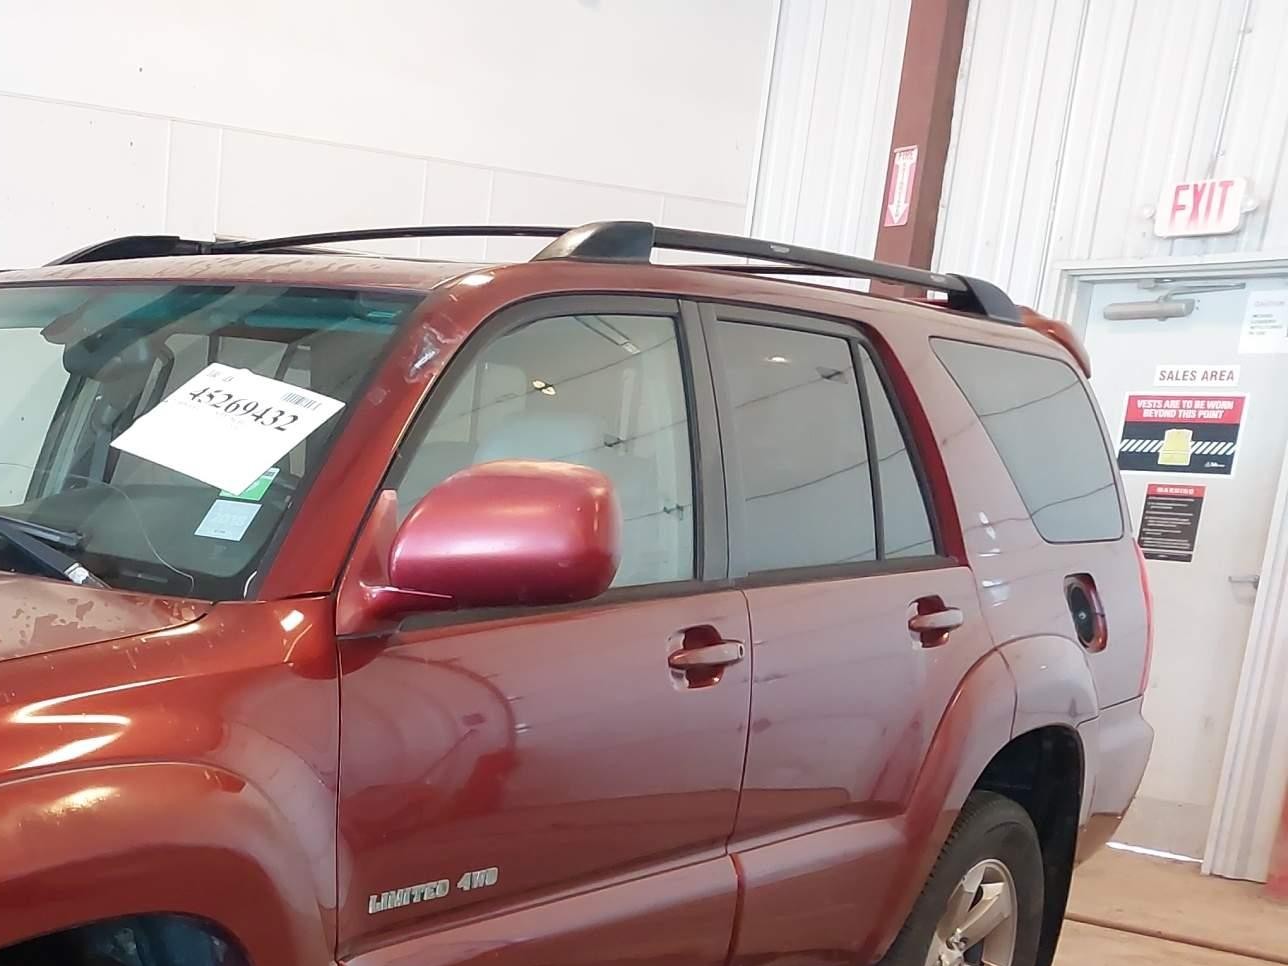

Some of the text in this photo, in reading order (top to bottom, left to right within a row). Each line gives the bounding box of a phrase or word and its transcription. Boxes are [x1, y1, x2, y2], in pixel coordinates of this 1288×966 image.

[1169, 180, 1235, 229] EXIT
[1159, 370, 1234, 381] SALES AREA
[189, 386, 299, 431] 45269432
[1137, 399, 1234, 410] VESTS ARE TO BE WORN
[1143, 408, 1225, 419] BEYOND THIS POINT
[368, 867, 499, 914] LIMITED 4WD
